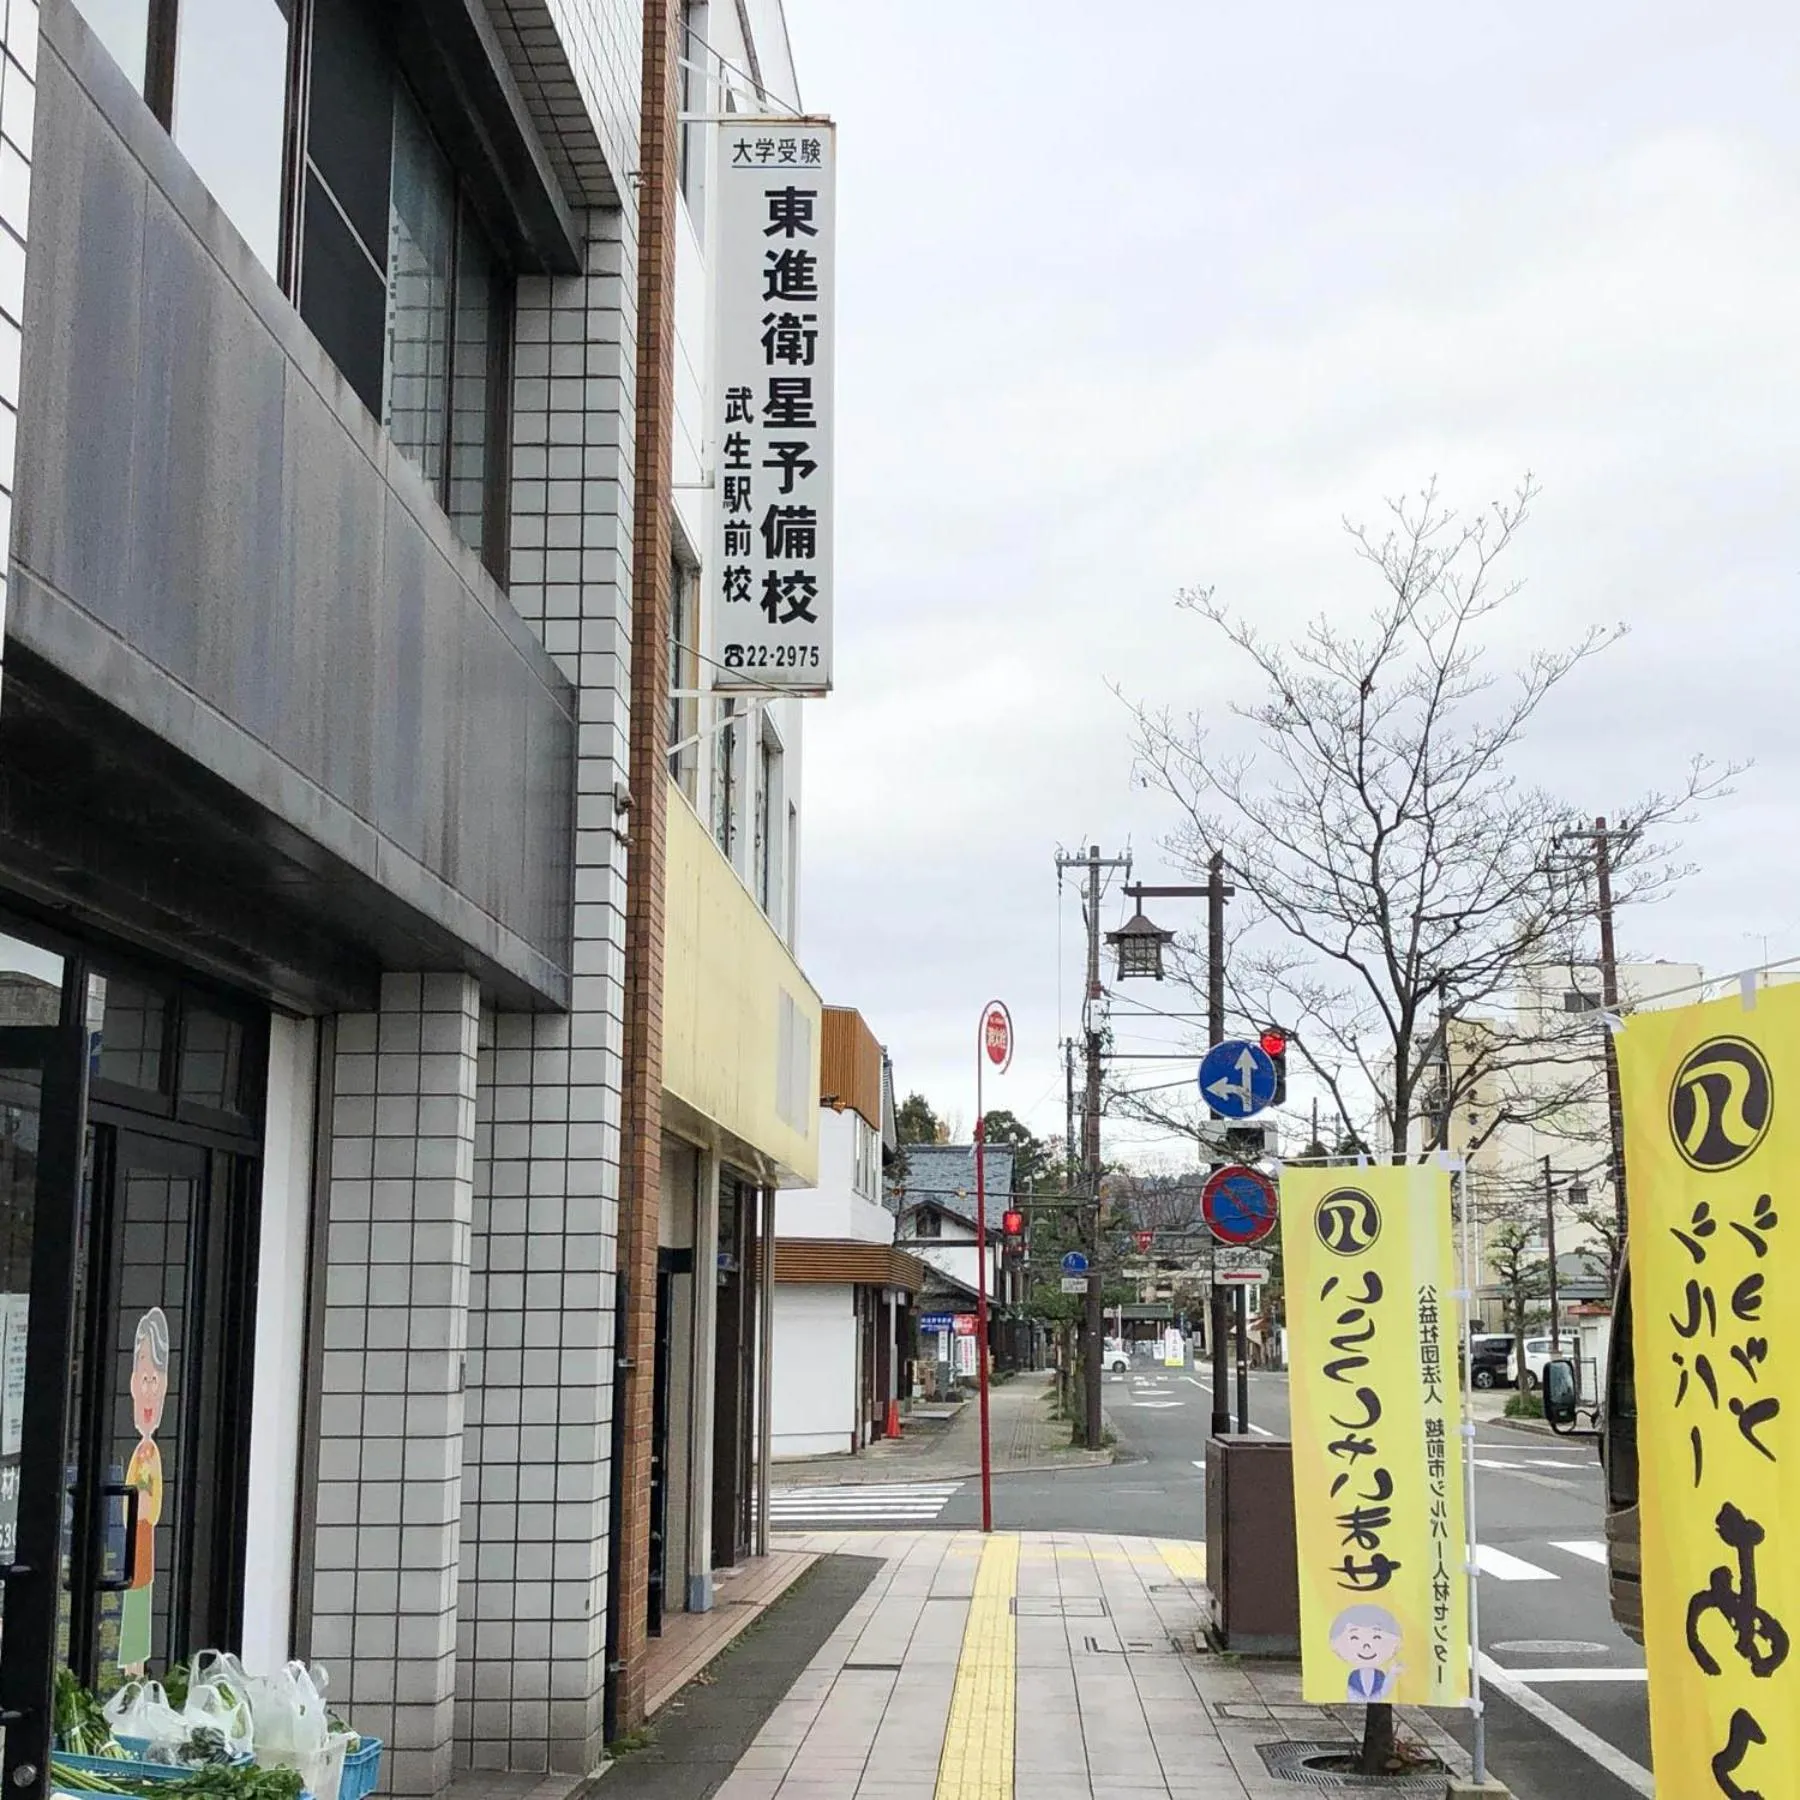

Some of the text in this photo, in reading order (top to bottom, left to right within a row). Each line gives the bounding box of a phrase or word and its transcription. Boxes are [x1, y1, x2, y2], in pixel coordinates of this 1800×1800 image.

[733, 138, 821, 163] 大学受験
[722, 387, 754, 604] 武生駅前校
[760, 186, 819, 624] 東進衛星予備校
